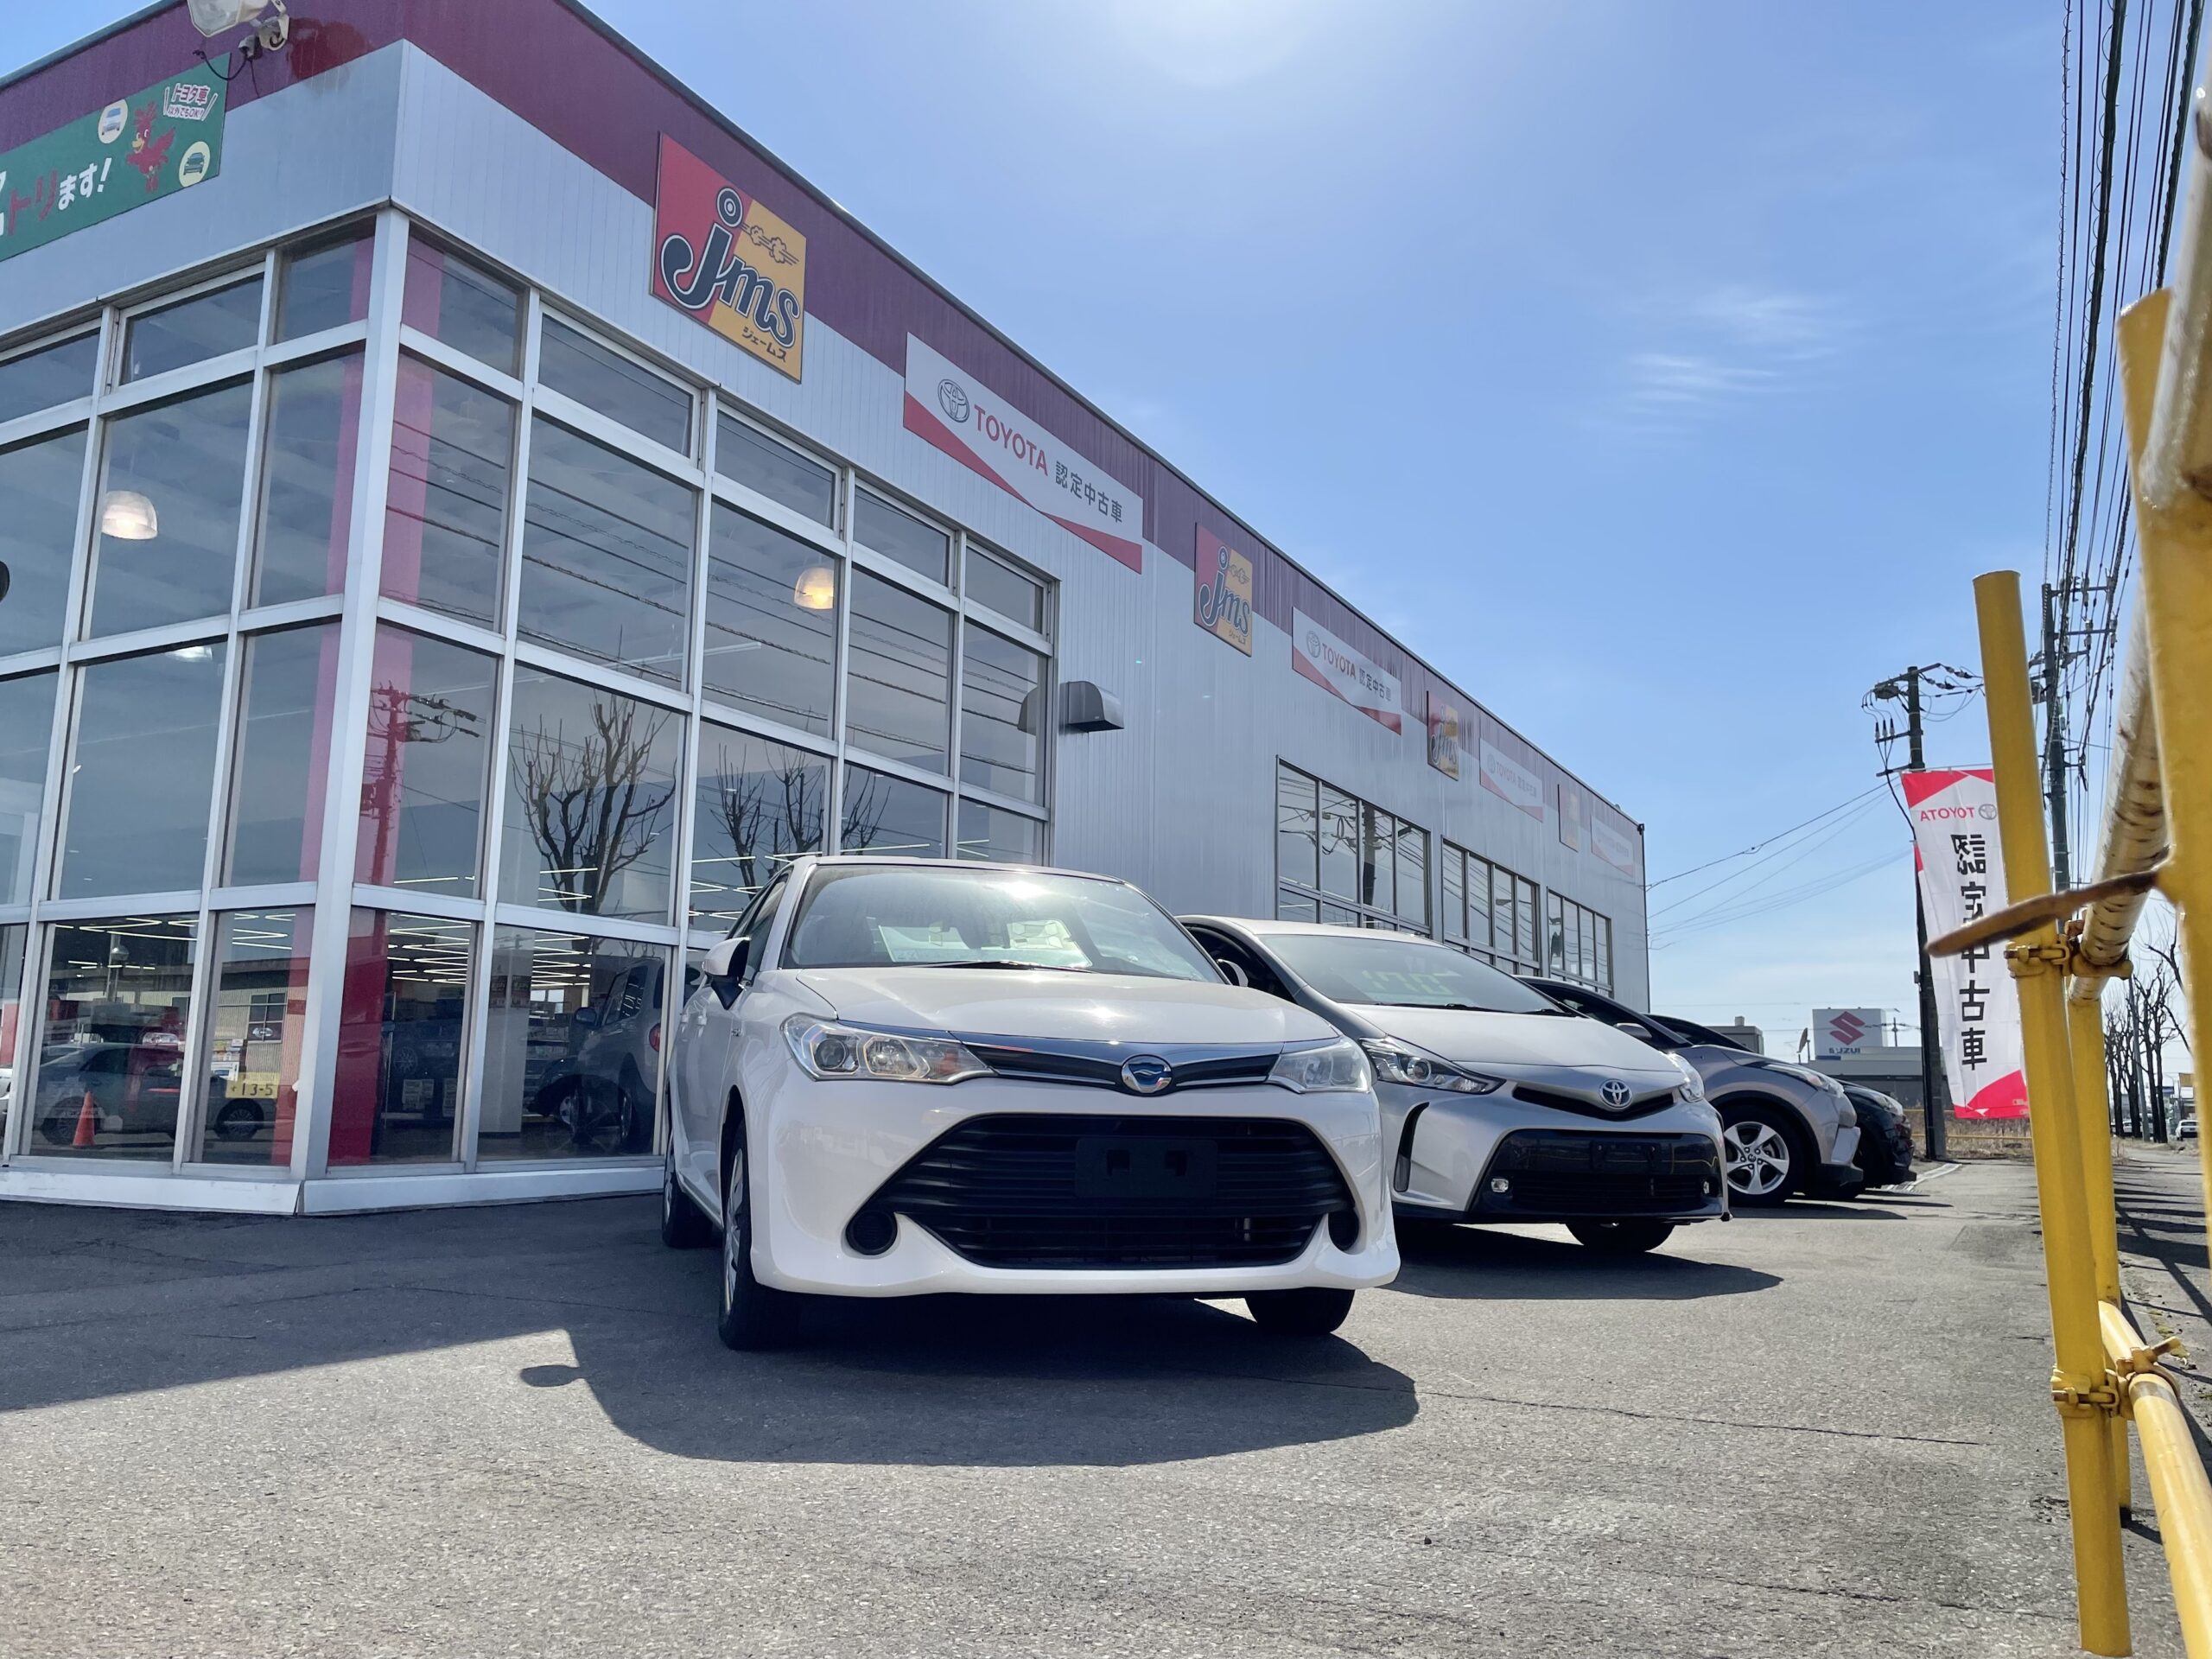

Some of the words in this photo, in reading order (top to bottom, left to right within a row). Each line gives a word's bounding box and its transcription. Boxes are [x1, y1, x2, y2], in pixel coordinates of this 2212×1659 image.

[173, 83, 210, 105] トヨタ車
[661, 188, 801, 348] jms
[742, 326, 787, 362] ジェームス
[974, 404, 1048, 476] TOYOTA
[1055, 461, 1122, 523] 認定中古車
[1198, 546, 1250, 637] jms
[1322, 643, 1356, 679] TOYOTA
